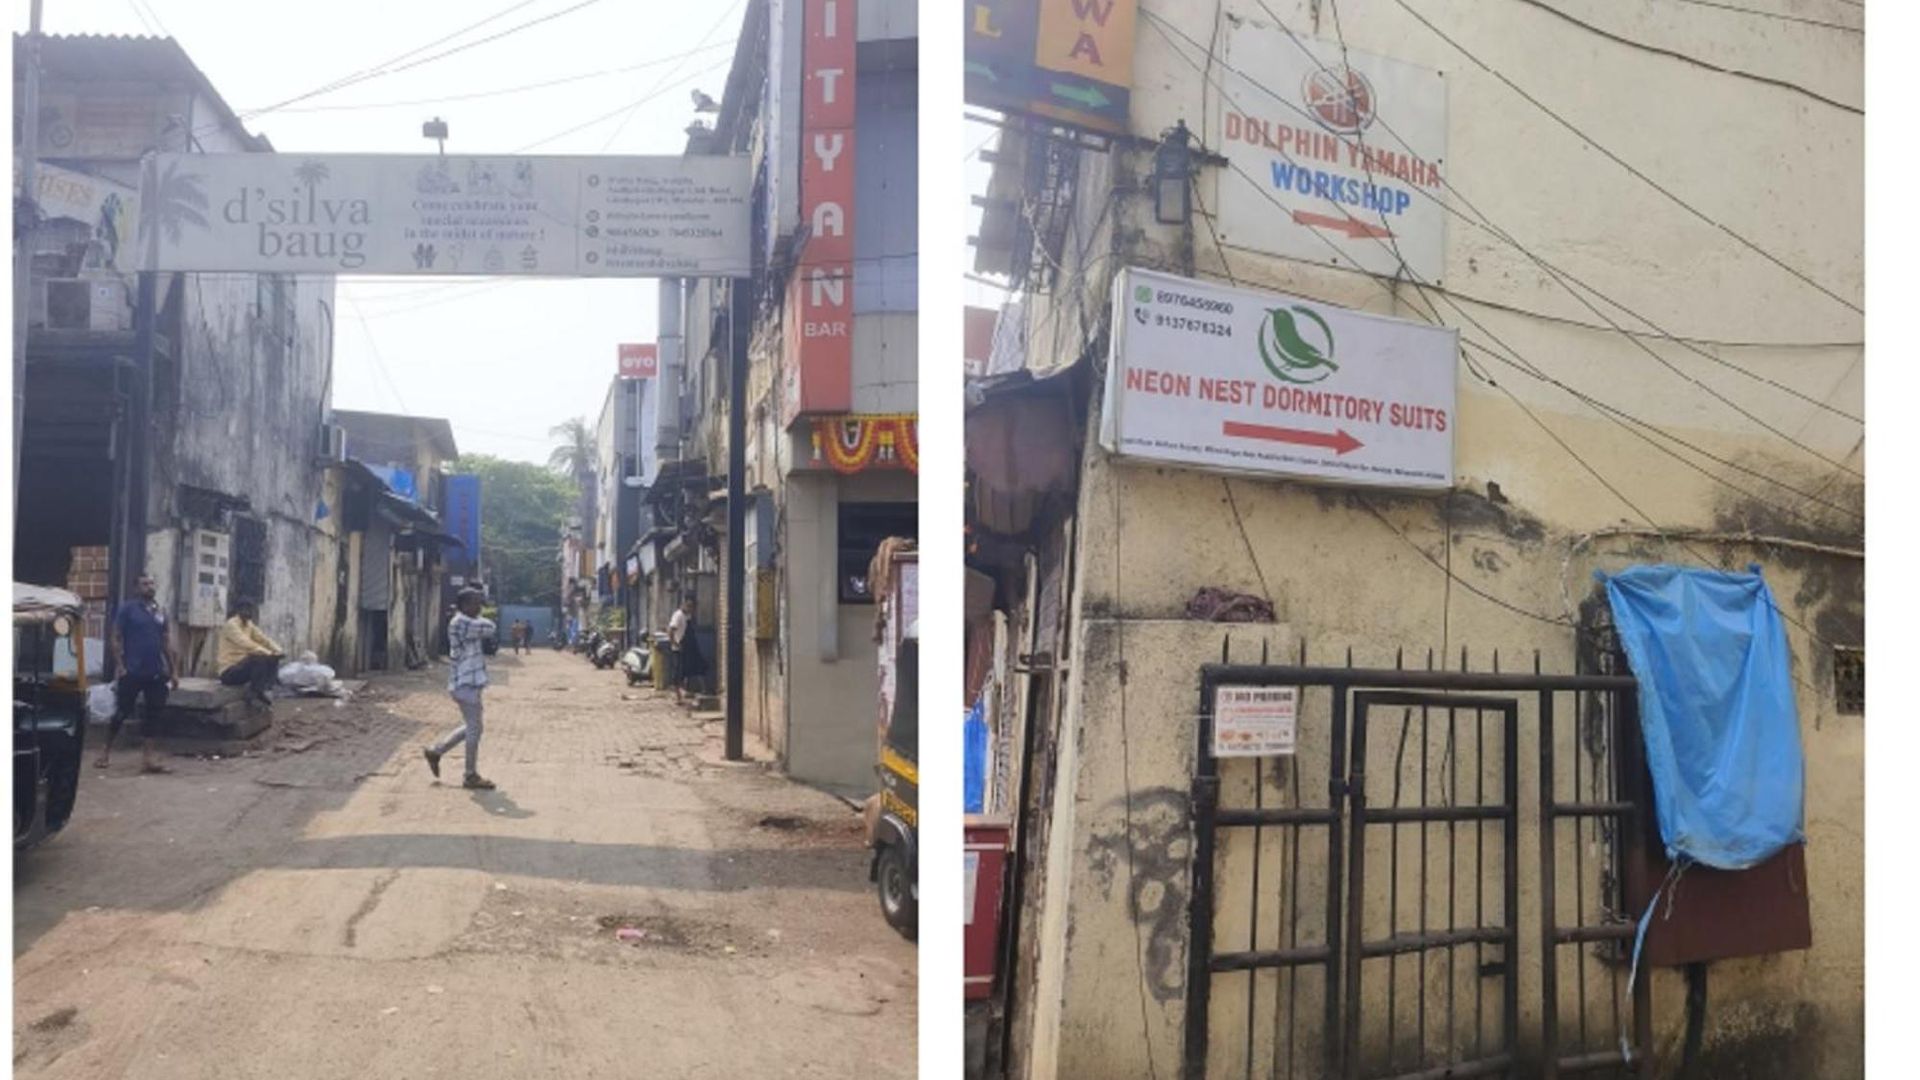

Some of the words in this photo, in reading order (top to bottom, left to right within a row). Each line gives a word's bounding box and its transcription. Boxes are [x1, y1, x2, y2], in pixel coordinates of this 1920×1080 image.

[1225, 112, 1338, 163] DOLPHIN
[1347, 141, 1441, 188] YAMAHA
[451, 199, 506, 211] celebrate
[510, 201, 538, 213] your
[1271, 160, 1411, 215] WORKSHOP
[257, 221, 367, 269] baug
[804, 322, 847, 337] BAR
[1126, 367, 1191, 397] NEON
[1199, 377, 1256, 406] NEST
[1263, 385, 1385, 424] DORMITORY
[1389, 402, 1447, 432] SUITS
